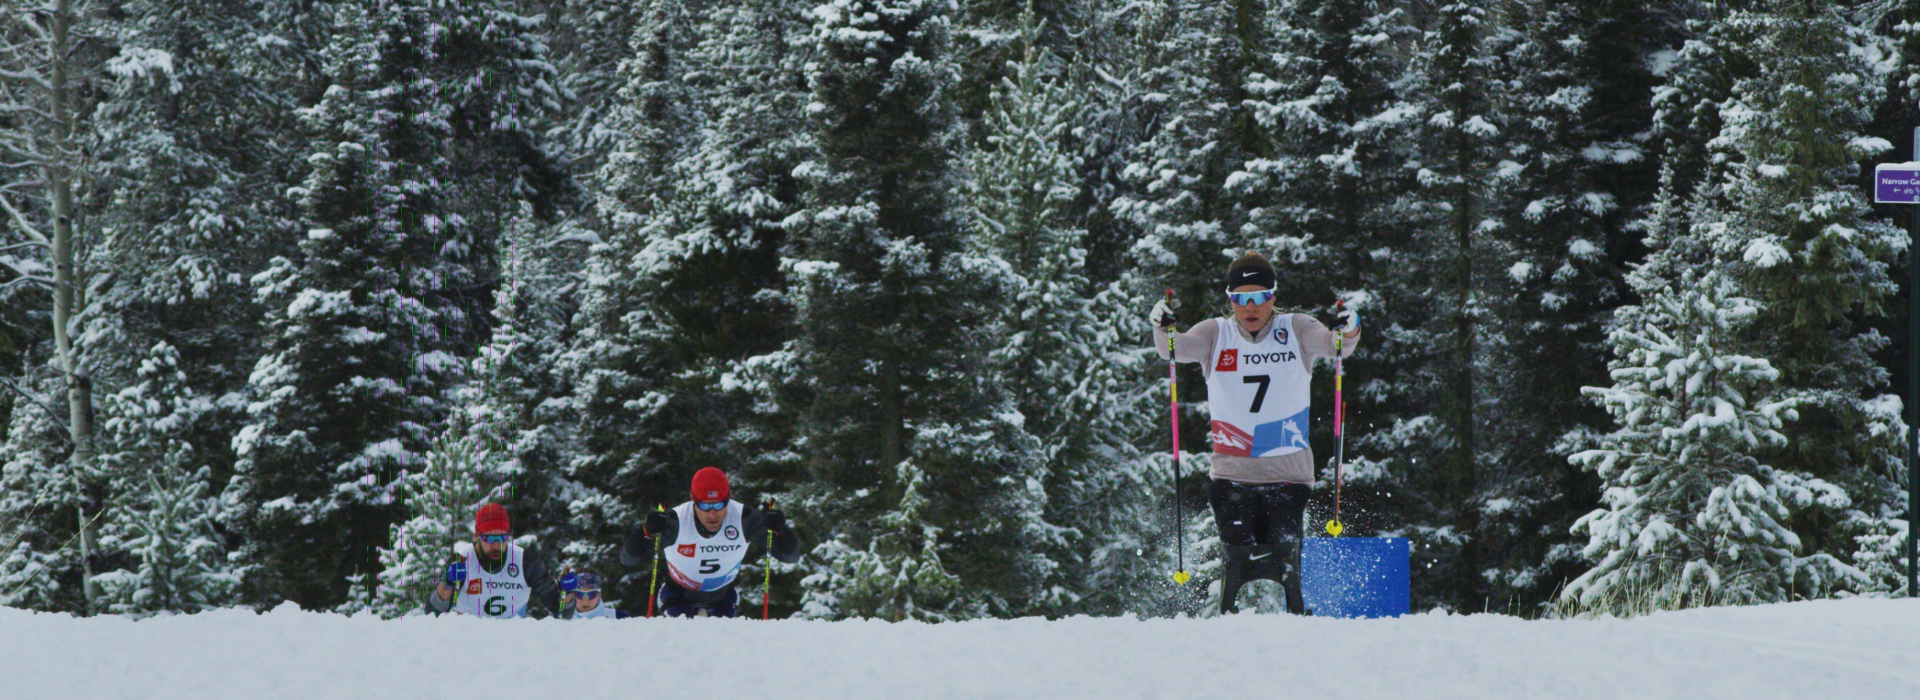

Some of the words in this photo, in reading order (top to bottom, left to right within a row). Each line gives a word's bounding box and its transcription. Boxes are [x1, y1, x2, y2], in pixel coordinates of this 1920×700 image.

[1243, 351, 1296, 364] TOYOTA
[1243, 374, 1271, 413] 7
[700, 545, 742, 553] TOYOTA
[699, 558, 721, 574] 5
[485, 582, 523, 590] TOYOTA
[483, 596, 507, 616] 6
